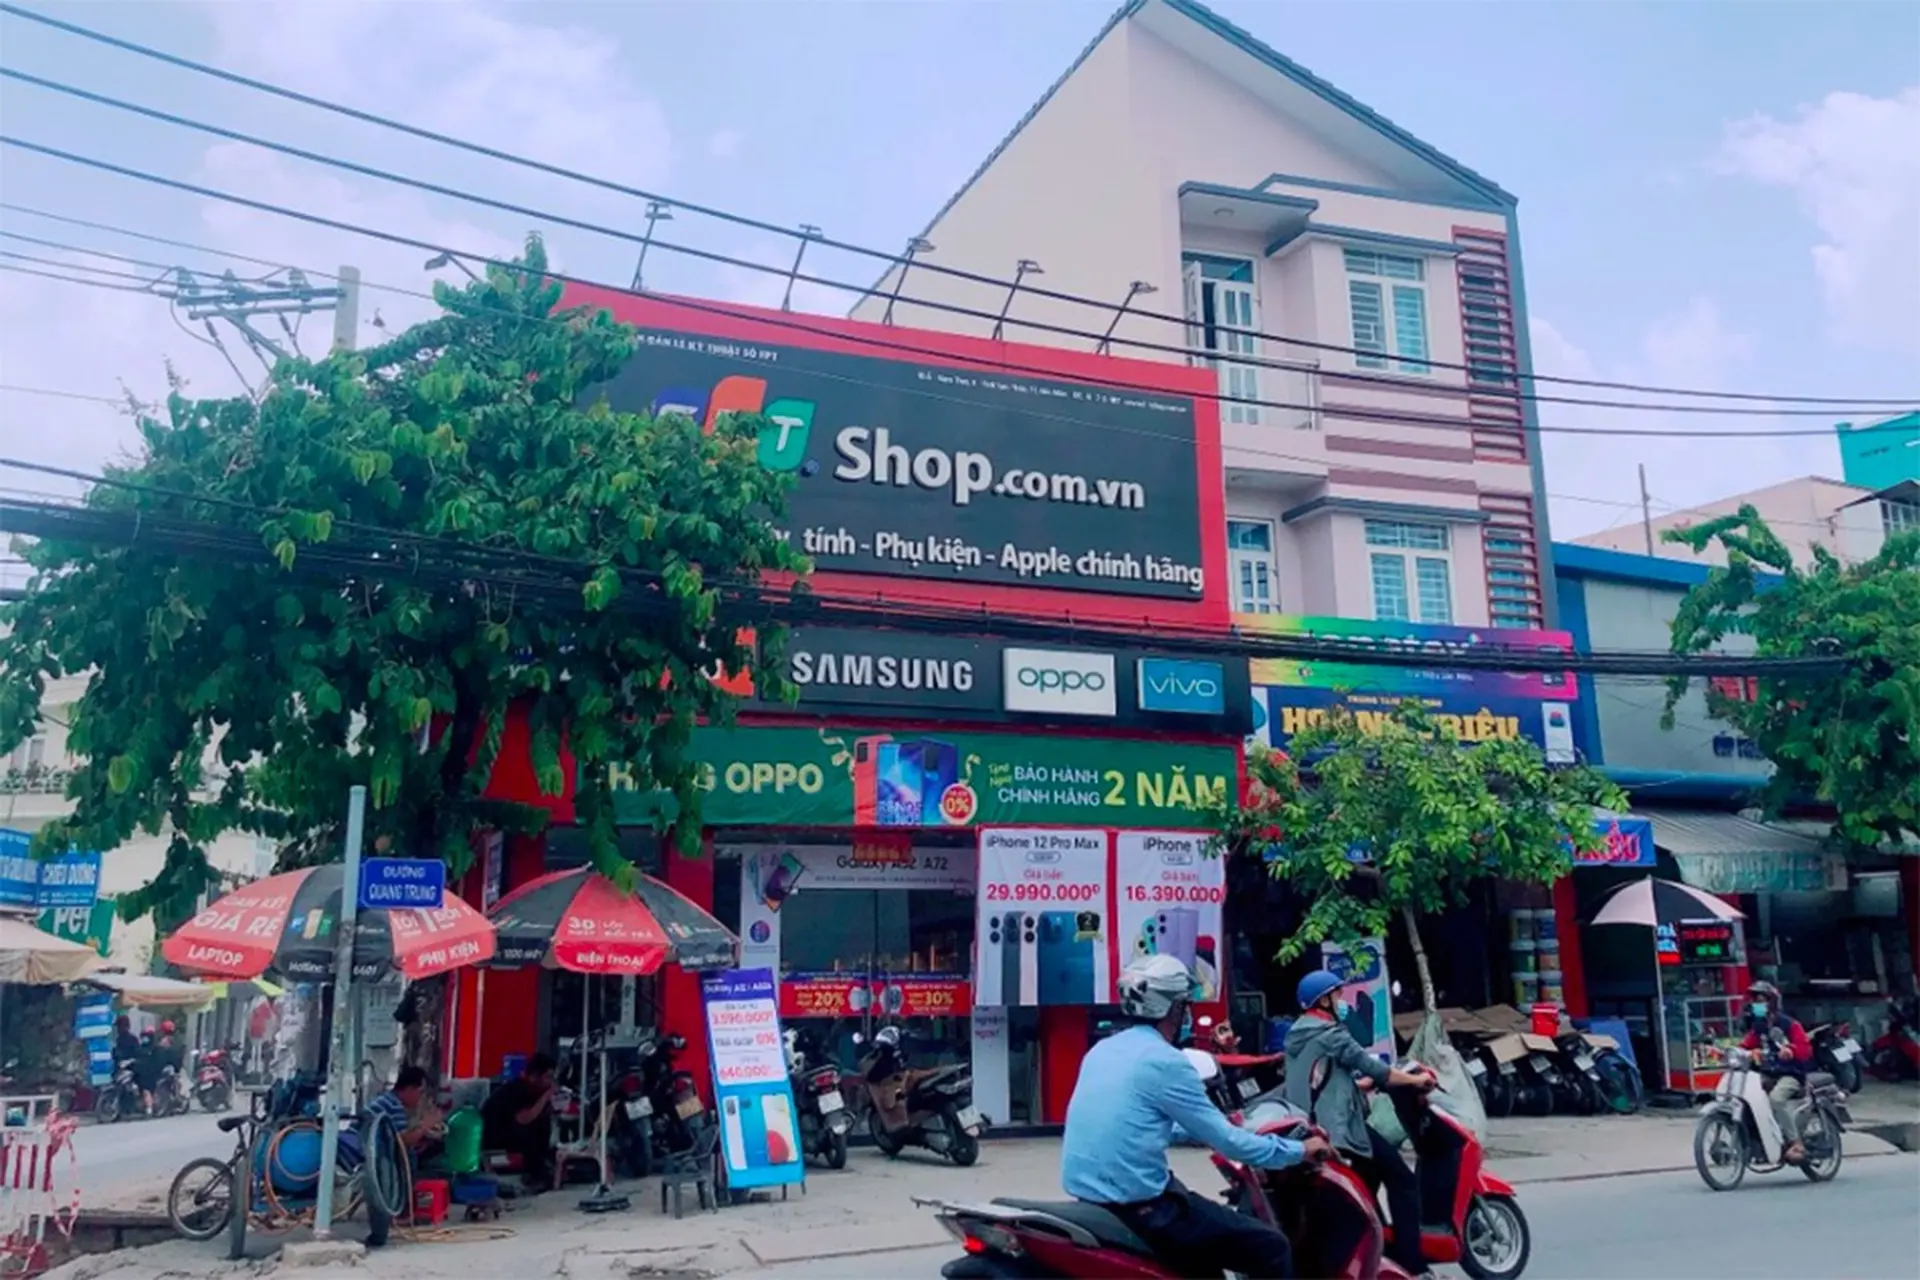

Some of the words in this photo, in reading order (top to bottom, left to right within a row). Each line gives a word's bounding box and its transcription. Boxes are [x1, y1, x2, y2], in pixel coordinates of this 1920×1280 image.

[804, 526, 856, 556] tính
[875, 531, 923, 568] Phụ
[927, 535, 981, 573] kiện
[1000, 543, 1070, 577] Apple
[1075, 549, 1141, 581] chính
[1145, 555, 1205, 592] hãng
[791, 651, 975, 692] SAMSUNG
[1148, 670, 1219, 698] vivo
[725, 761, 824, 794] OPPO
[1051, 764, 1099, 785] HÀNH
[998, 783, 1051, 805] CHÍNH
[1103, 769, 1127, 806] 2
[1136, 764, 1227, 809] NĂM
[986, 835, 1030, 849] iPhone
[1034, 835, 1048, 849] 12
[1050, 835, 1072, 850] Pro
[1074, 836, 1099, 850] Max
[1143, 836, 1192, 853] iPhone
[382, 864, 426, 879] ĐƯỜNG
[923, 856, 948, 871] A72
[368, 882, 404, 901] QUANG
[405, 883, 438, 901] TRUNG
[193, 908, 247, 933] GIÁ
[187, 944, 245, 967] LAPTOP
[417, 949, 447, 969] PHỤ
[447, 940, 481, 961] KIỆN
[606, 953, 645, 968] THOẠI
[814, 991, 845, 1007] 20%
